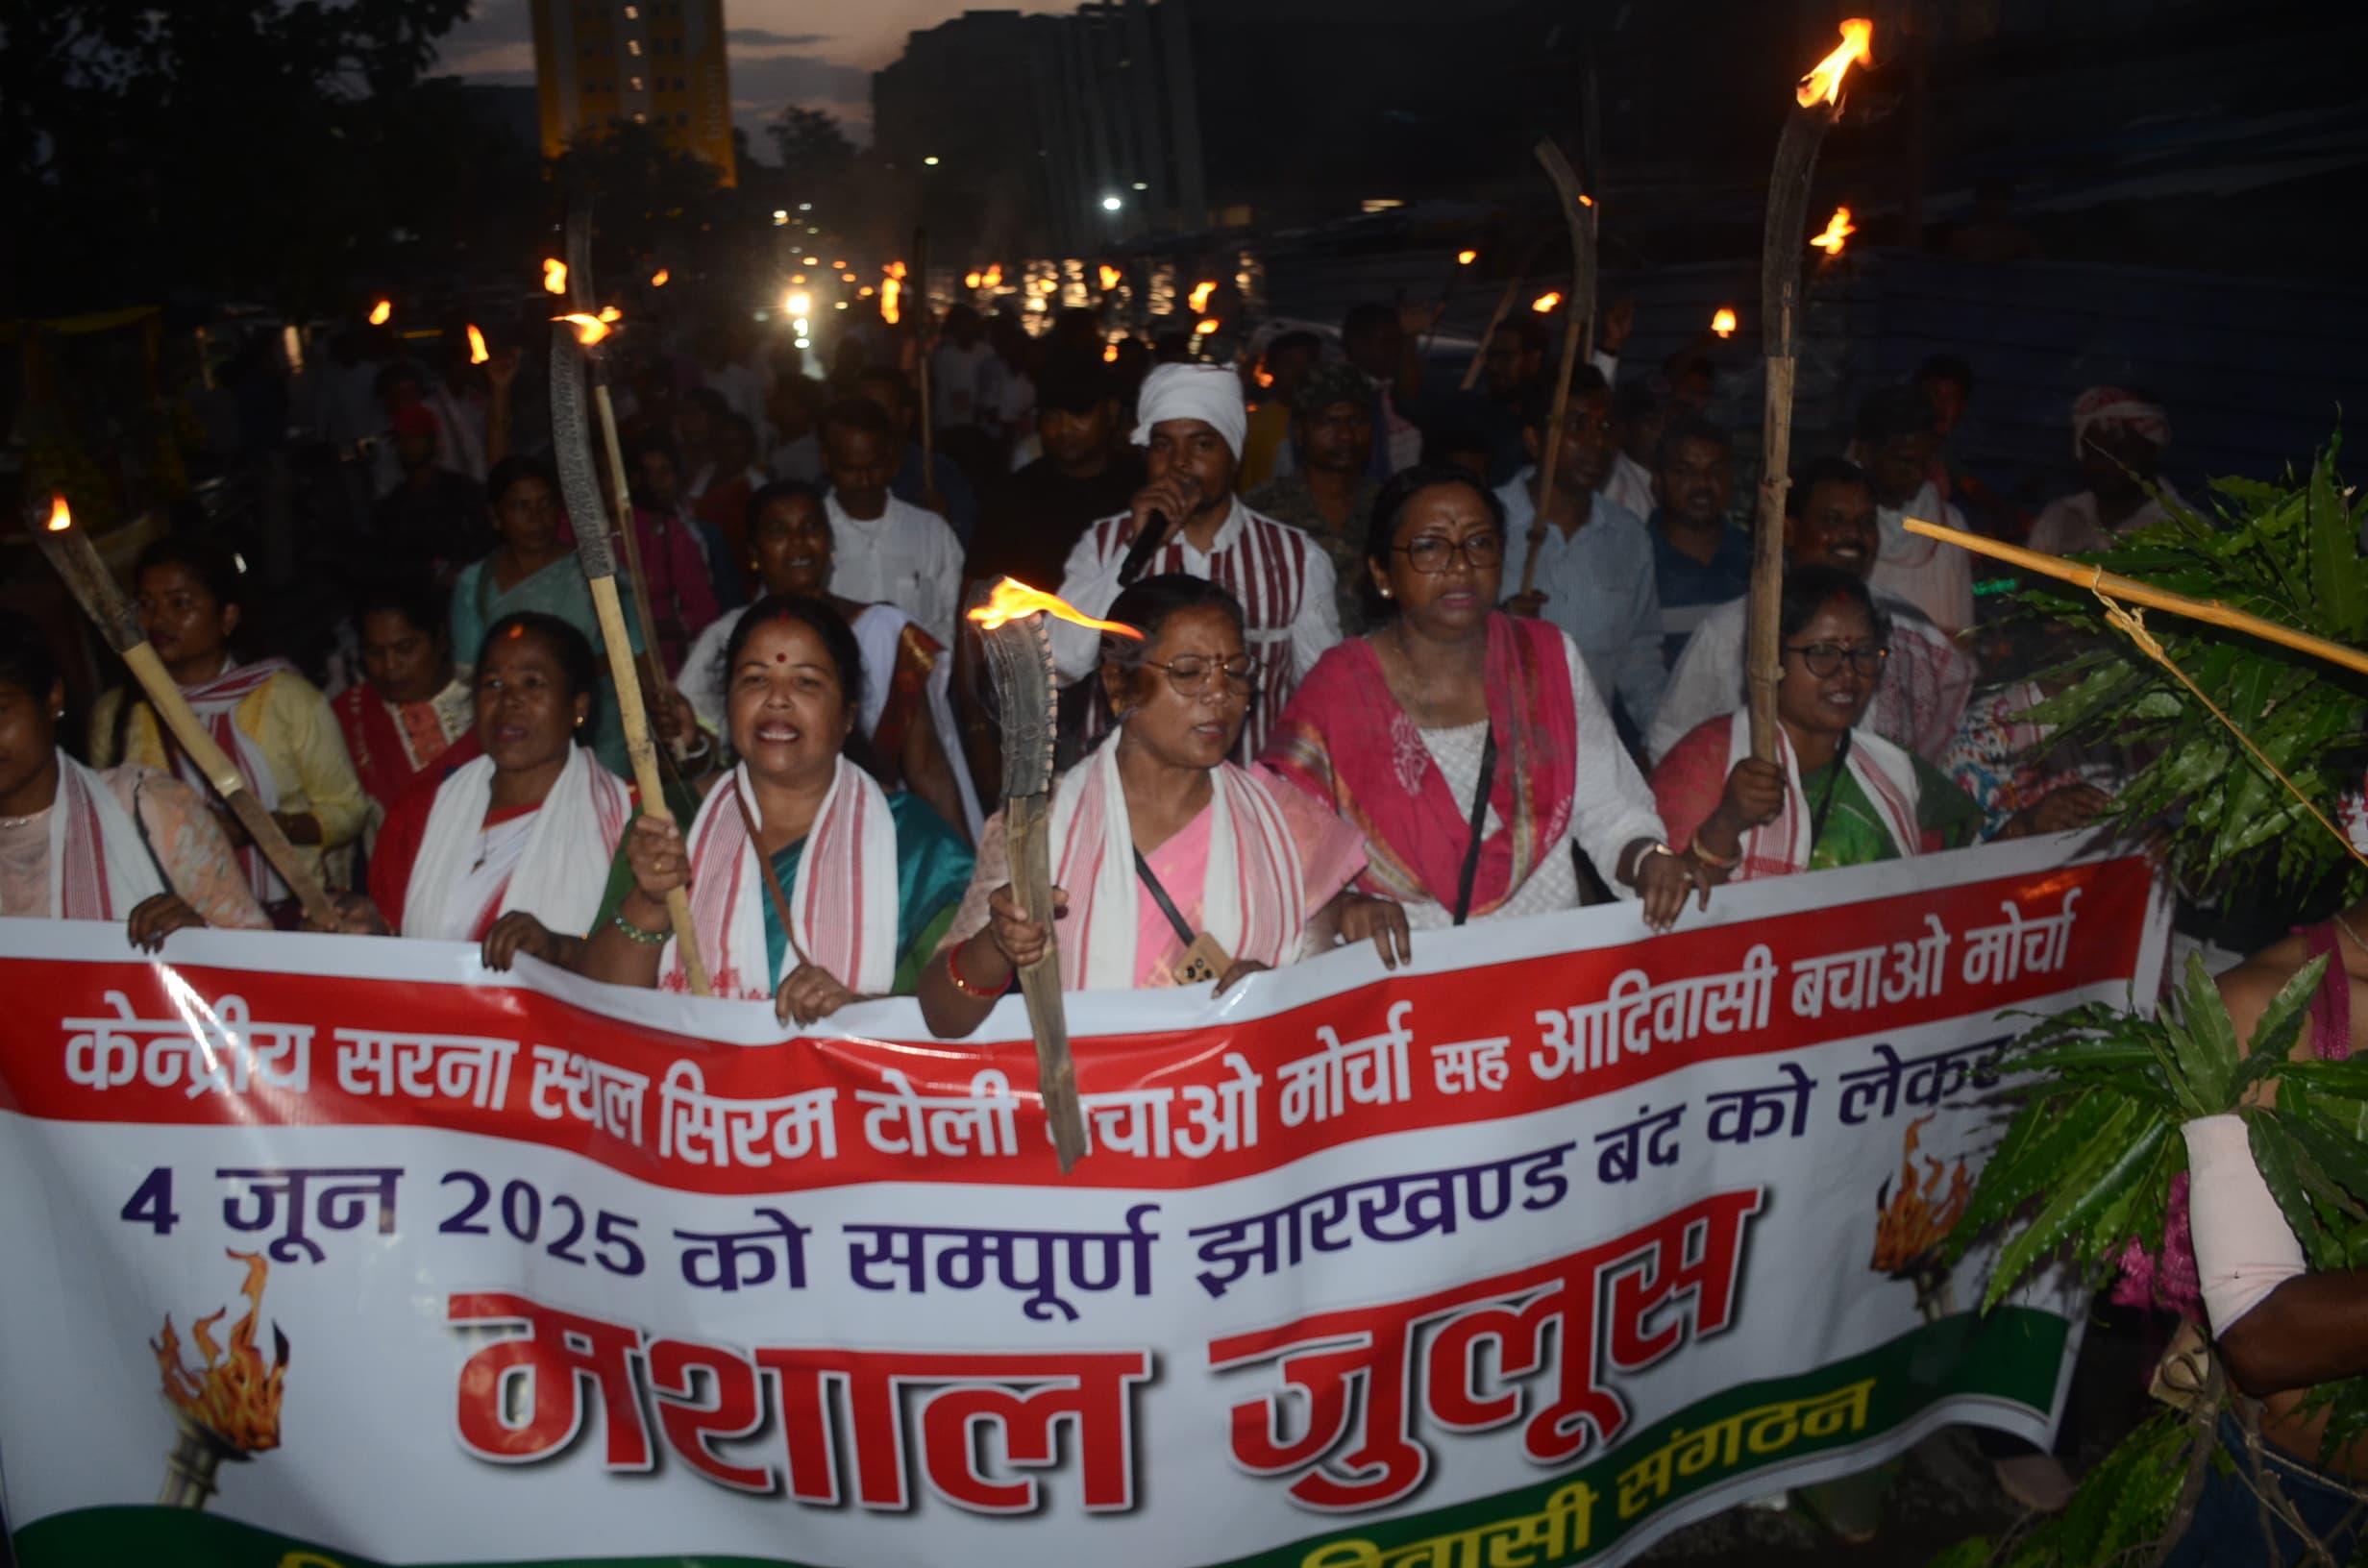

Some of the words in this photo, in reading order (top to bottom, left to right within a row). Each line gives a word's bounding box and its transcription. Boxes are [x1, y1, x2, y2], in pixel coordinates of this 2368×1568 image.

[62, 990, 315, 1099] केन्द्रीय
[333, 1027, 519, 1112] सरना
[530, 1045, 650, 1147] स्थल
[658, 1058, 838, 1166] सिरम
[856, 1068, 1021, 1157] टोली
[1277, 1000, 1413, 1127] मोर्चा
[1431, 1036, 1511, 1094] सह
[1529, 943, 1778, 1081] आदिवासी
[1790, 913, 1952, 1018] बचाओ
[1961, 887, 2083, 986] मोर्चा
[120, 1166, 180, 1235] 4
[215, 1167, 405, 1264] जून
[438, 1170, 647, 1278] 2025
[672, 1208, 811, 1292] को
[843, 1204, 1161, 1323] सम्पूर्ण
[1188, 1140, 1577, 1300] झारखण्ड
[1593, 1105, 1688, 1185] बंद
[1706, 1062, 1817, 1144] को
[1838, 1033, 2016, 1125] लेकर
[447, 1290, 1157, 1515] मशाल
[1208, 1185, 1764, 1512] जुलूस
[1616, 1377, 1877, 1522] संगठन
